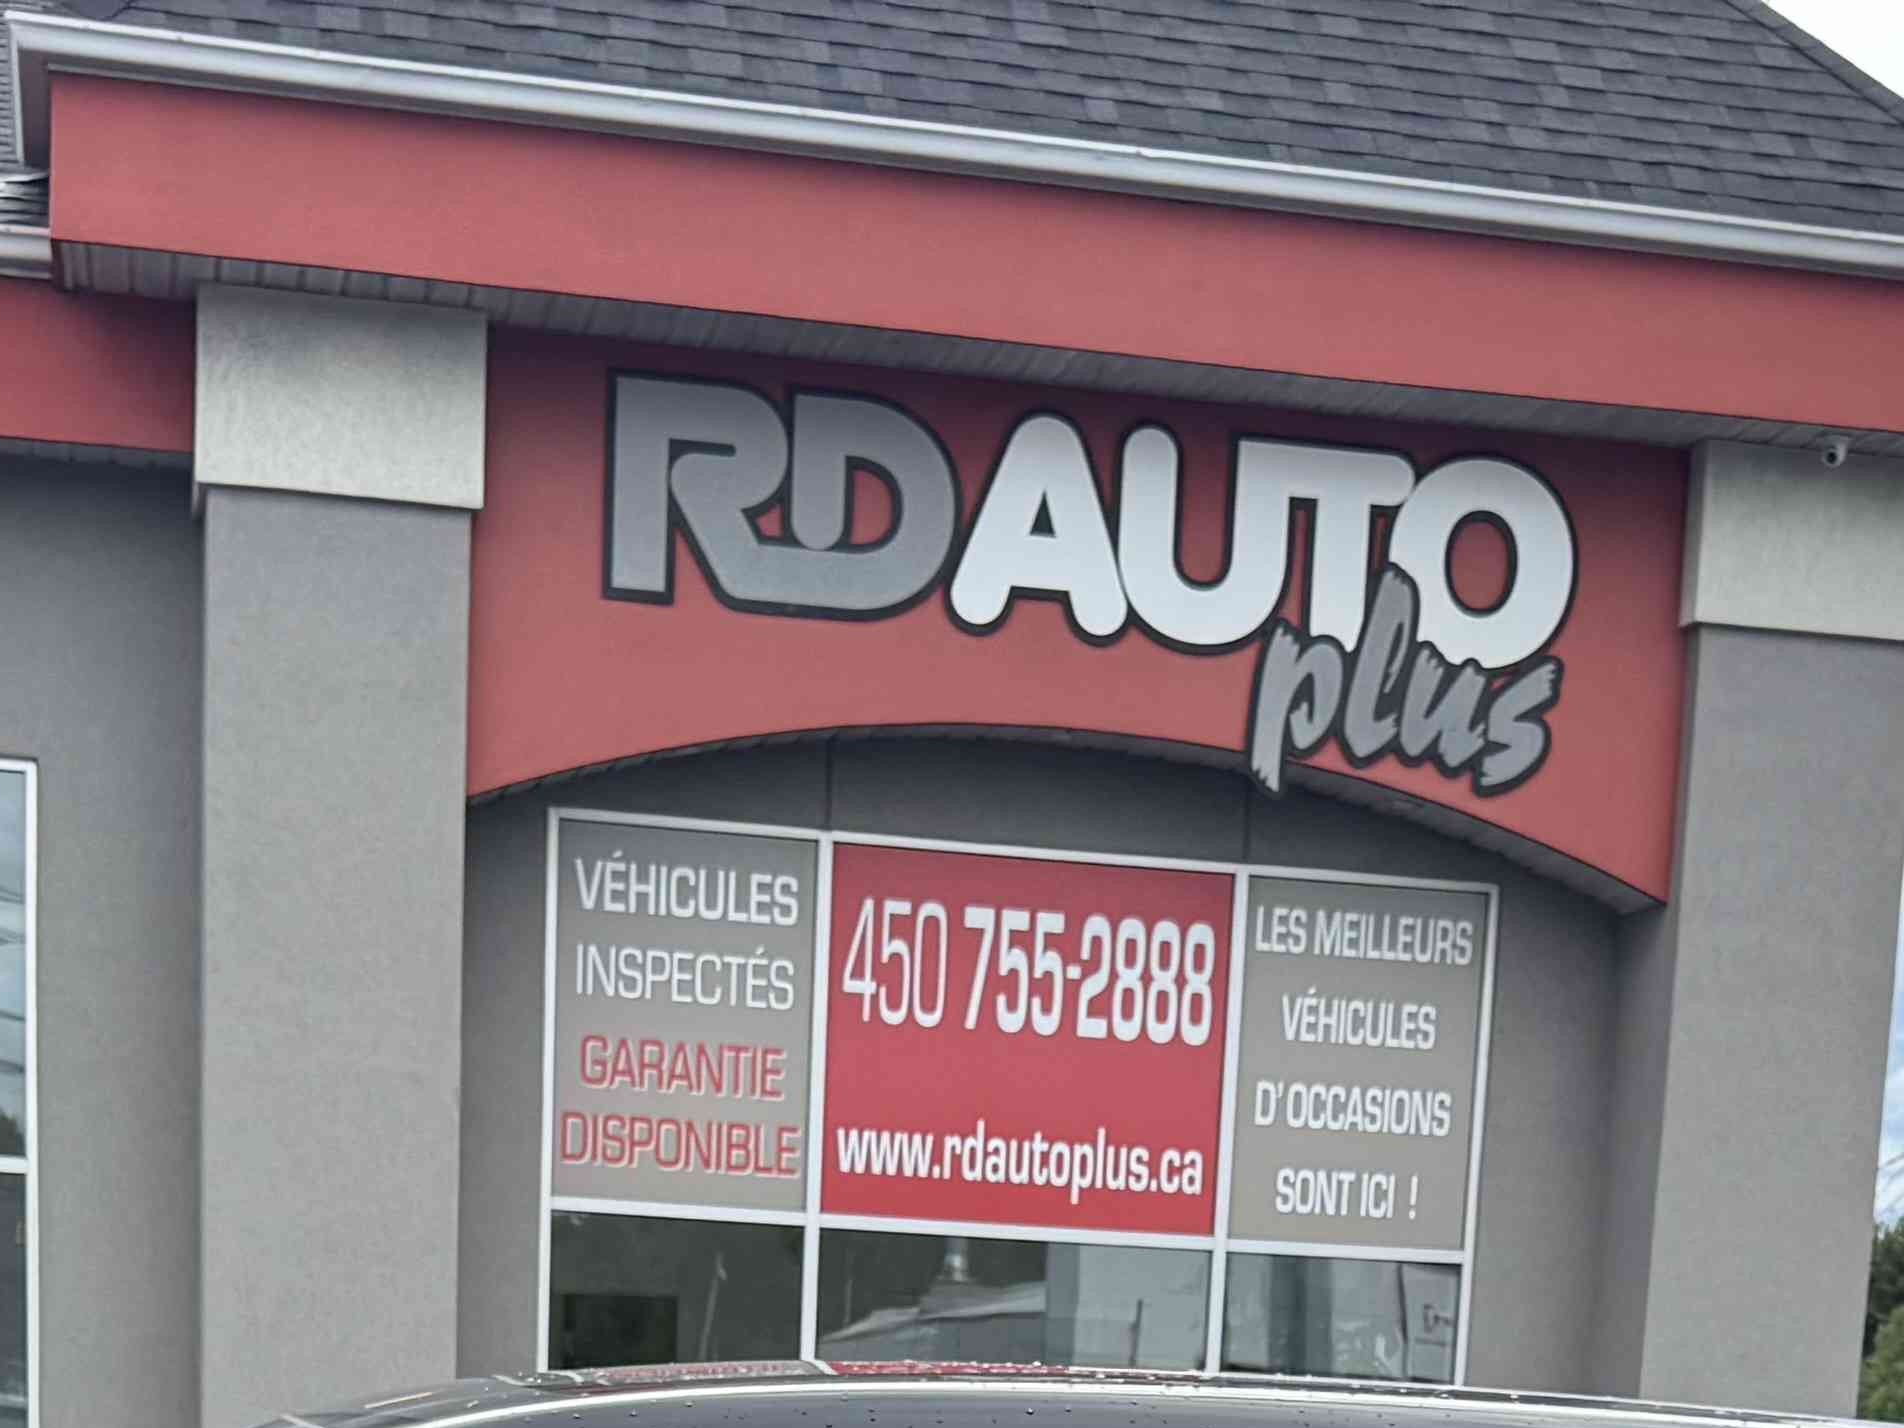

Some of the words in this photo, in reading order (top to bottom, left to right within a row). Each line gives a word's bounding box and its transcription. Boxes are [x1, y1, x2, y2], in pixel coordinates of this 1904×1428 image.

[1247, 562, 1559, 792] plus
[574, 850, 800, 927] VÉHICULES
[1254, 905, 1307, 954] LES
[1313, 909, 1473, 966] MEILLEURS
[576, 945, 795, 1011] INSPECTÉS
[842, 897, 948, 1028] 450
[963, 905, 1216, 1046] 755-2888
[1281, 985, 1437, 1051] VÉHICULES
[580, 1033, 787, 1102] GARANTIE
[559, 1110, 801, 1179] DISPONIBLE
[836, 1119, 1204, 1205] www.rdautoplus.ca
[1274, 1167, 1356, 1218] SONT
[1359, 1171, 1395, 1220] ICI
